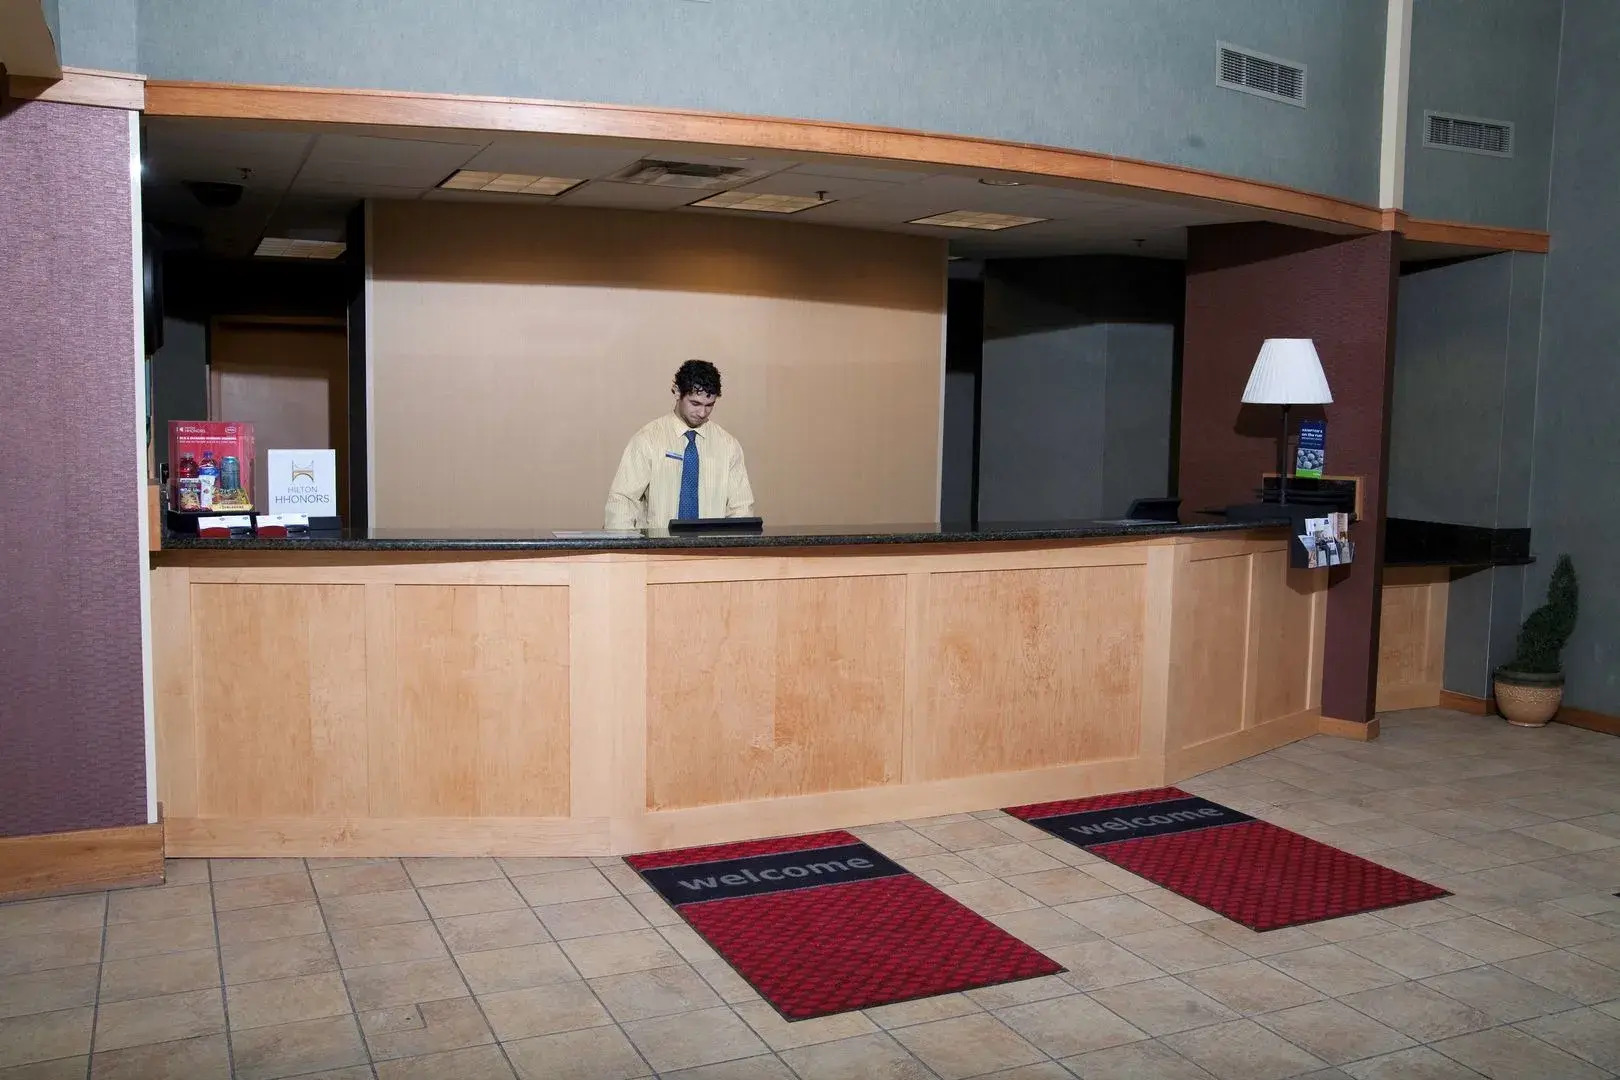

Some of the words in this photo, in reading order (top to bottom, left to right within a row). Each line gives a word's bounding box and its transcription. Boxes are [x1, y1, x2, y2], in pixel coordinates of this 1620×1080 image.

[275, 495, 329, 504] HHONORS
[1069, 807, 1224, 835] welcome
[677, 856, 875, 892] welcome
